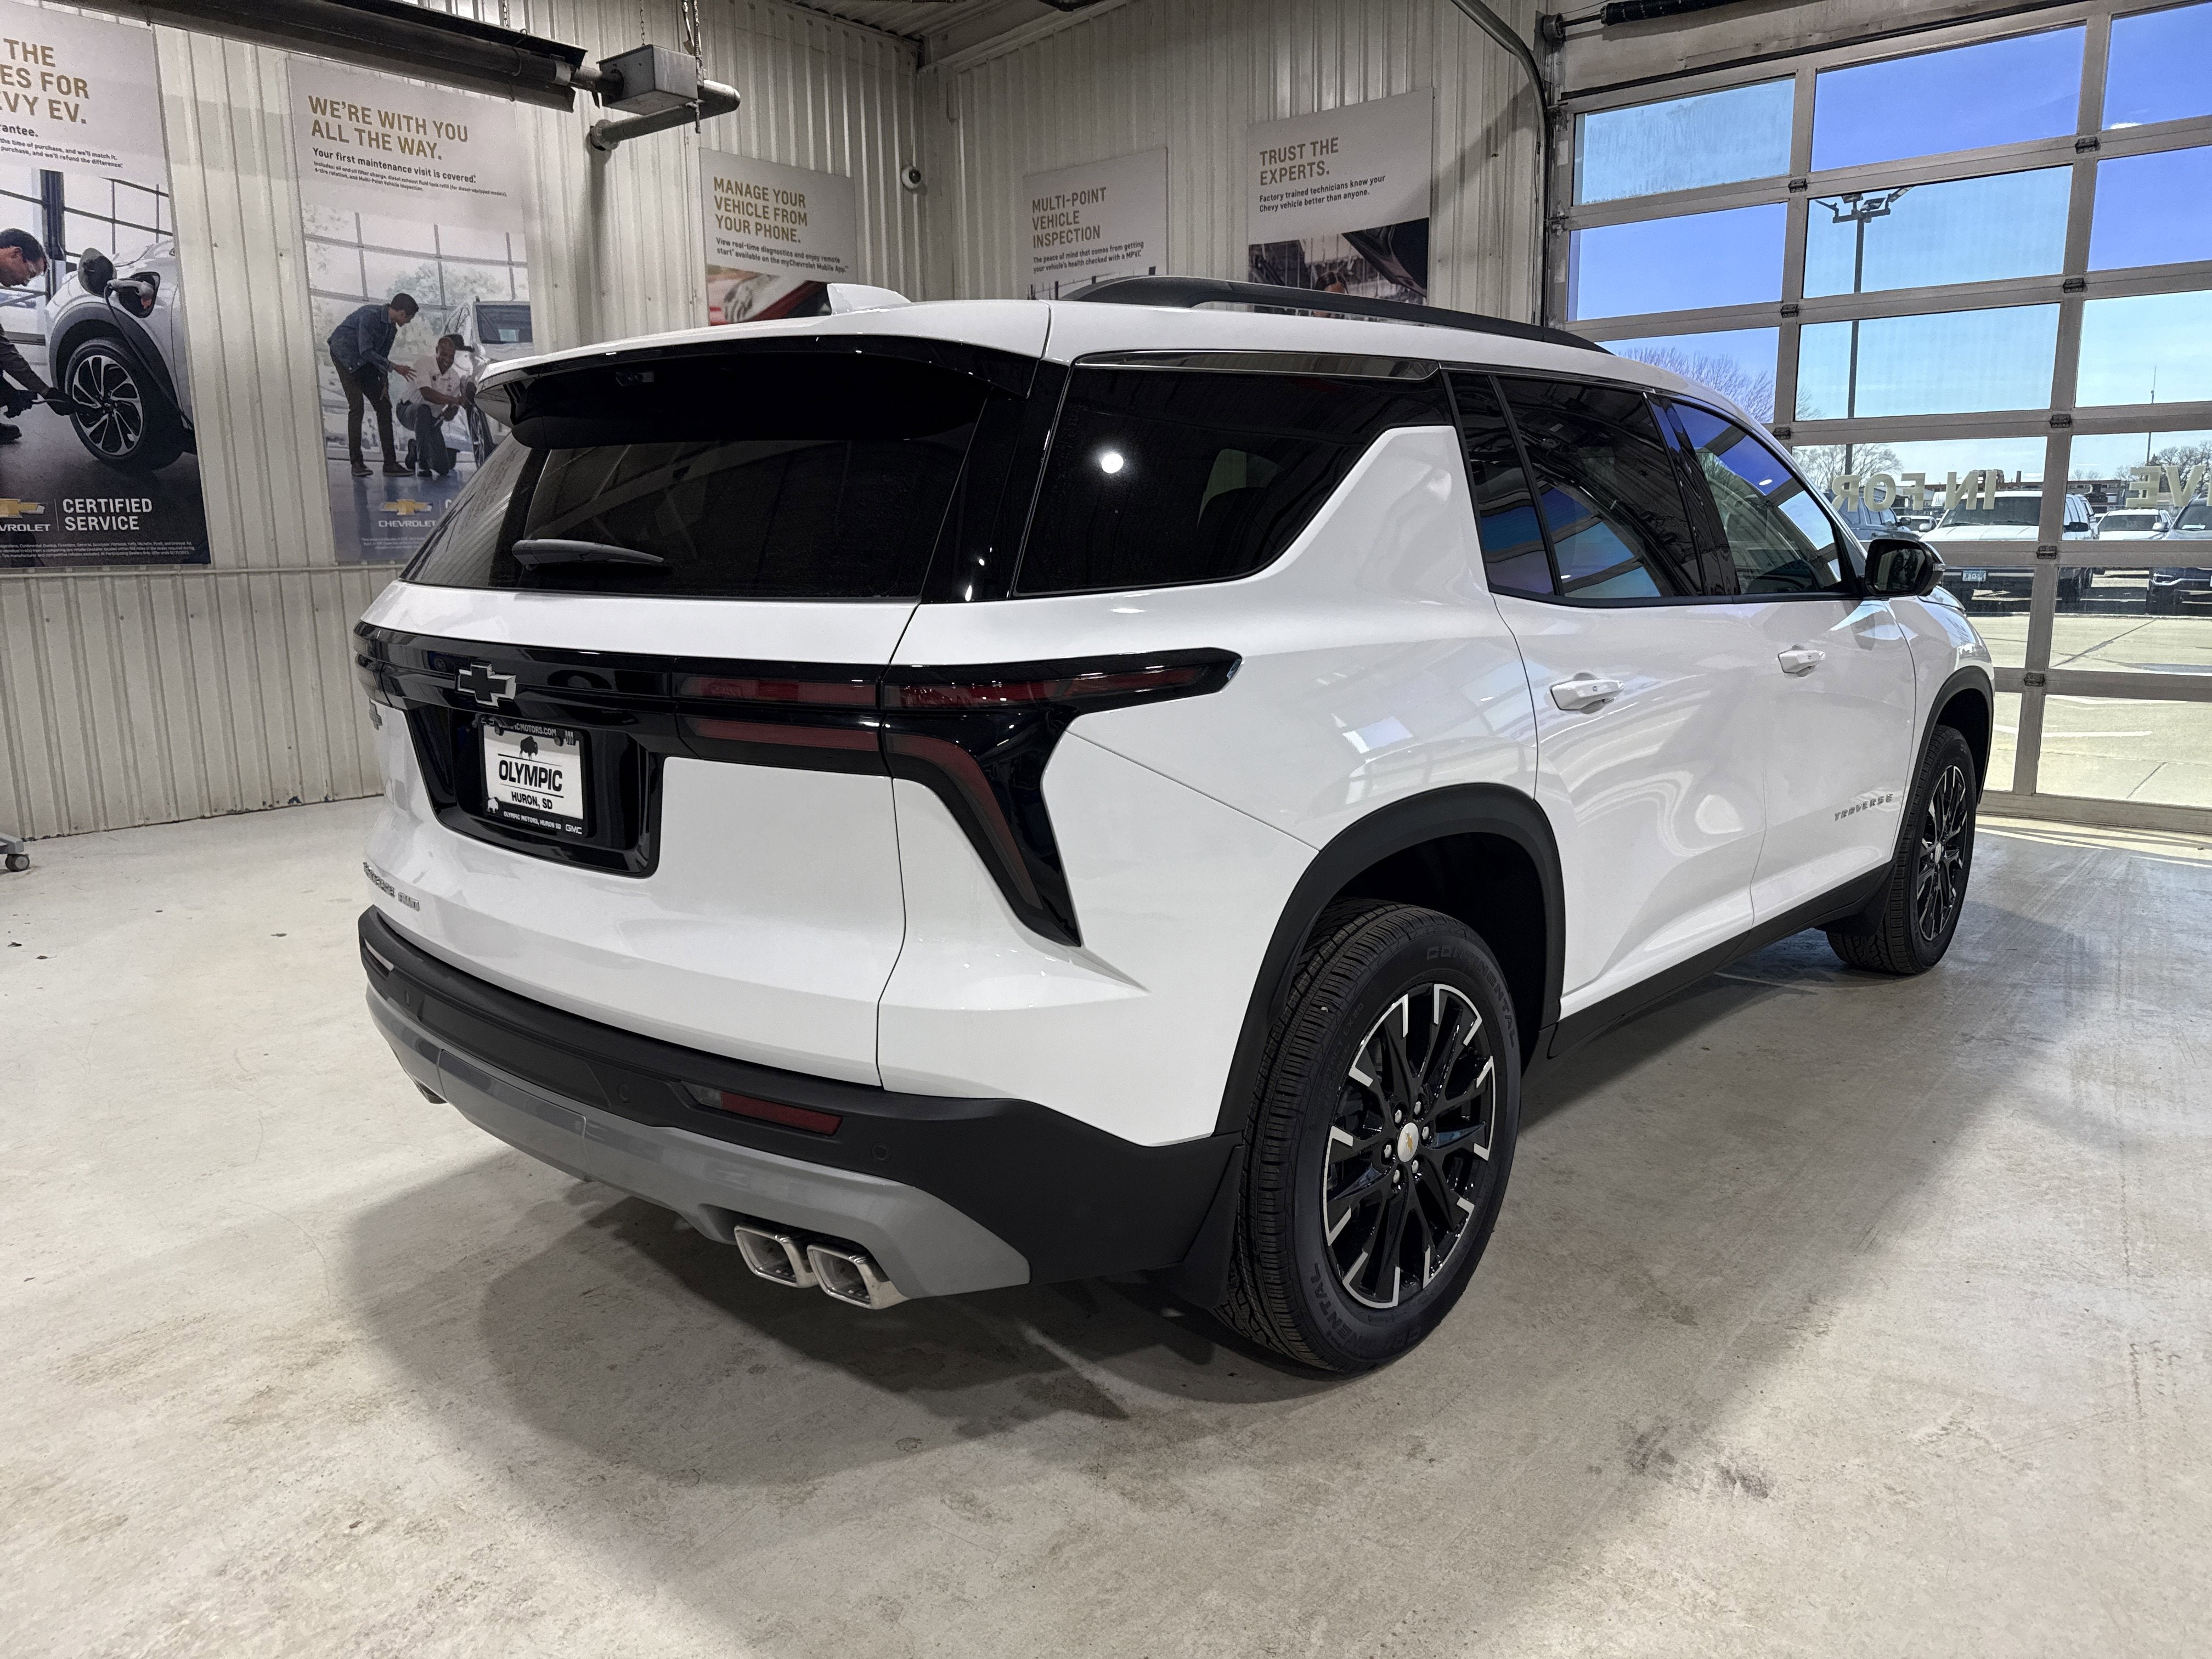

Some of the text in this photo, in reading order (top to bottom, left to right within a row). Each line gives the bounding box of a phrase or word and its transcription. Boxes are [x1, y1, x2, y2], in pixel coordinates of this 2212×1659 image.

[3, 38, 55, 67] THE
[41, 71, 89, 99] FOR
[0, 91, 87, 124] VY EV.
[308, 95, 468, 143] WE'RE WITH YOU
[0, 124, 38, 137] antee.
[311, 119, 442, 160] ALL THE WAY.
[313, 147, 333, 159] Your
[336, 152, 356, 163] first
[358, 158, 412, 173] maintenance
[414, 166, 432, 177] visit
[433, 169, 441, 178] is
[1260, 137, 1339, 166] TRUST THE
[1260, 160, 1330, 186] EXPERTS.
[714, 176, 806, 208] MANAGE YOUR
[1032, 187, 1107, 213] MULTI-POINT
[1259, 175, 1386, 203] Factory trained technicians know your
[1259, 189, 1370, 212] Chevy vehicle better than anyone.
[714, 195, 808, 227] VEHICLE FROM
[1032, 210, 1080, 230] VEHICLE
[715, 214, 801, 243] YOUR PHONE.
[1033, 225, 1101, 249] INSPECTION
[716, 237, 731, 246] View
[732, 241, 759, 252] real-time
[761, 245, 793, 257] diagnostics
[805, 253, 820, 262] enjoy
[735, 251, 760, 261] available
[781, 259, 816, 269] myChevrolet
[1043, 253, 1058, 263] peace
[1065, 251, 1079, 259] mind
[1124, 241, 1144, 251] getting
[1034, 266, 1045, 274] your
[1085, 256, 1107, 265] checked
[1108, 252, 1121, 261] with
[63, 498, 153, 513] CERTIFIED
[65, 516, 139, 531] SERVICE
[499, 760, 563, 792] OLYMPIC
[511, 791, 553, 810] HURON, SD
[1834, 793, 1893, 822] TRAVERSE
[504, 811, 520, 821] OLYMPIC
[565, 824, 583, 834] GMC
